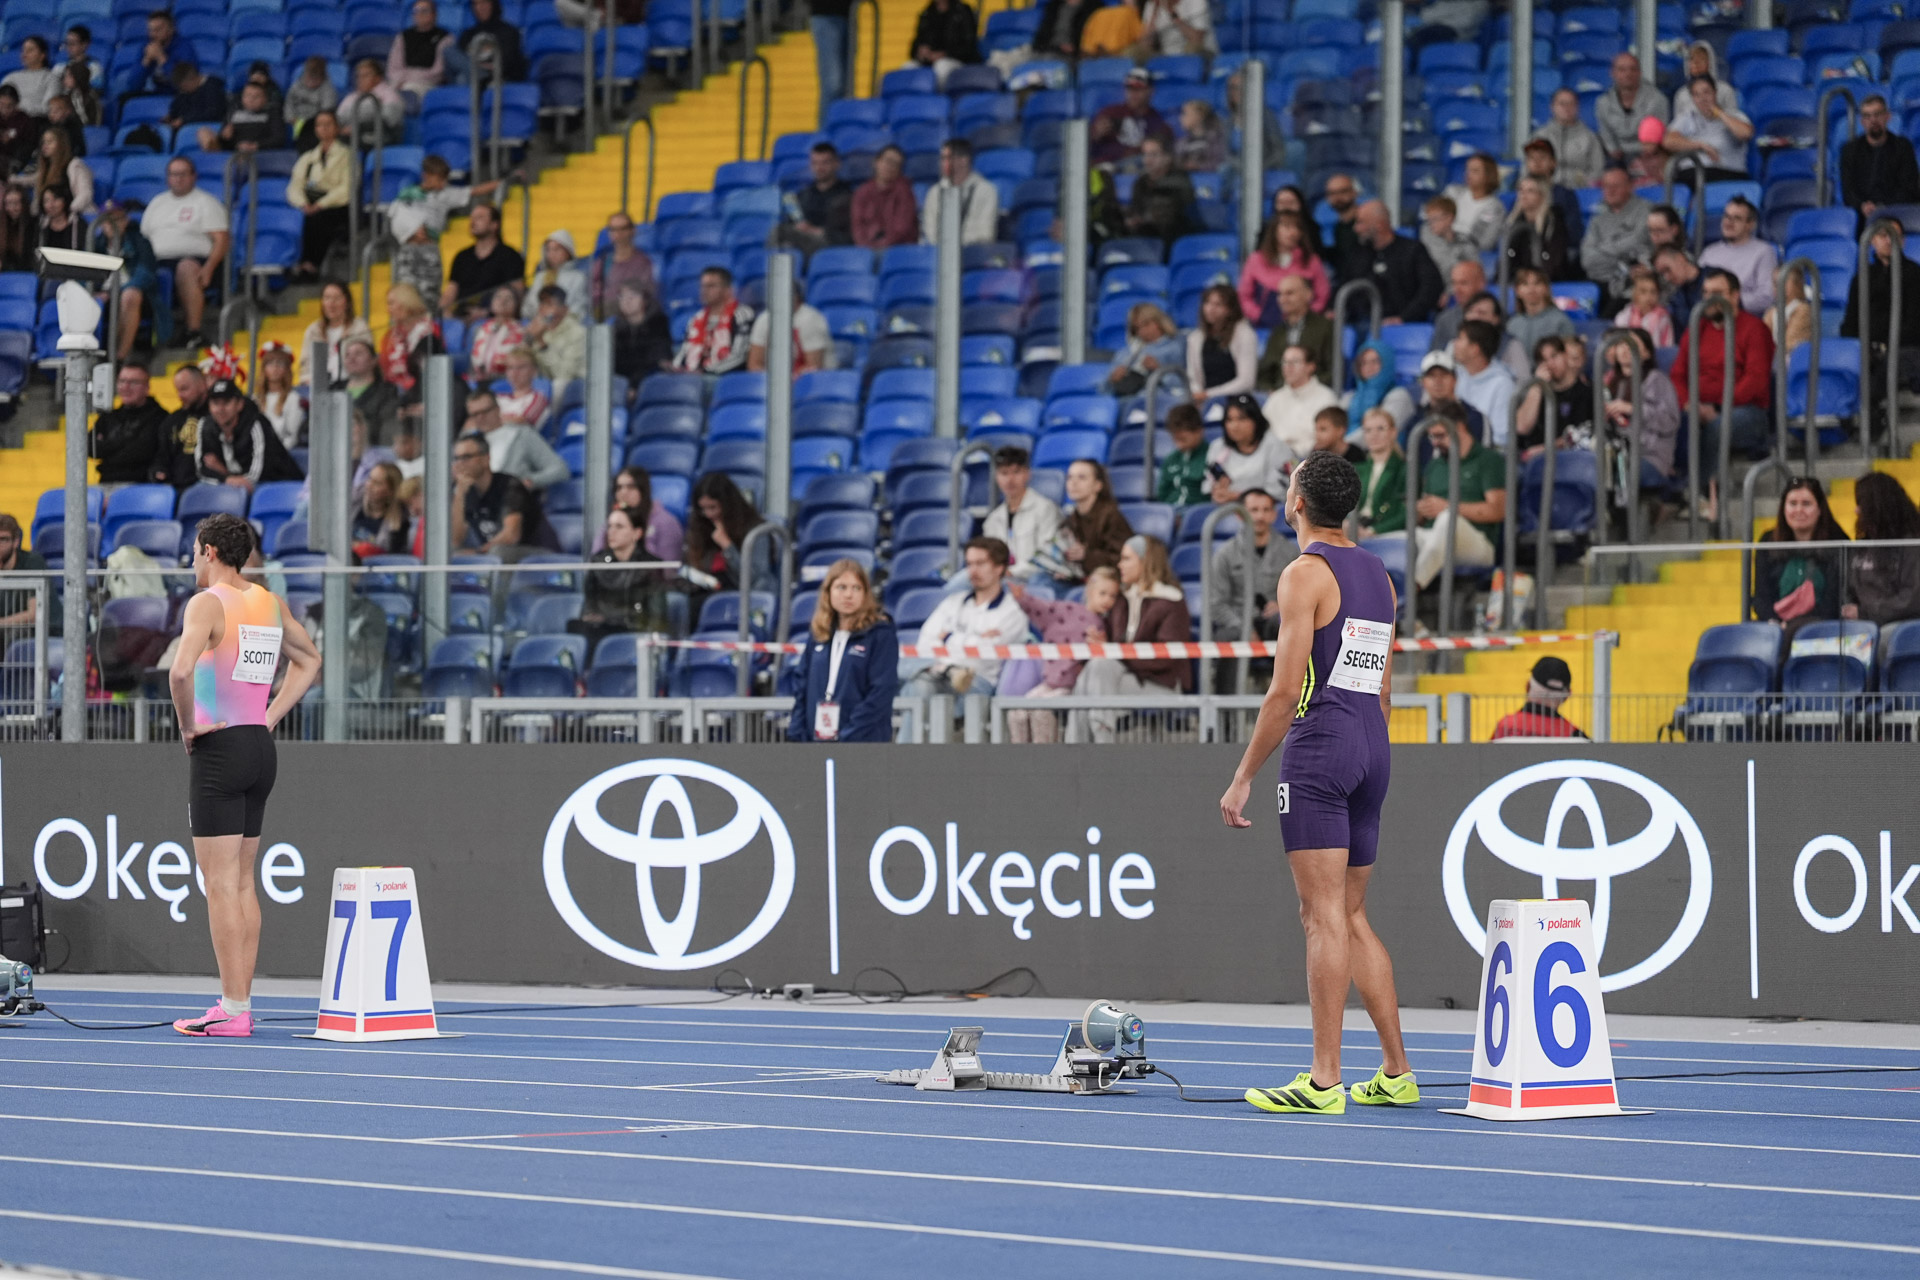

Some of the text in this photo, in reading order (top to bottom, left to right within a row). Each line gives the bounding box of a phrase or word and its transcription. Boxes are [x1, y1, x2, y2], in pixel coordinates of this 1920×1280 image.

[243, 650, 275, 665] SCOTTI
[1343, 649, 1386, 671] SEGERS
[1279, 786, 1285, 812] 6
[33, 814, 305, 923] Okęe
[383, 882, 408, 892] polanik
[869, 822, 1156, 941] Okęcie
[333, 900, 357, 1001] 7
[370, 900, 412, 1002] 7
[1498, 918, 1514, 930] polanik
[1547, 917, 1581, 931] polanik
[1484, 941, 1513, 1068] 6
[1533, 941, 1592, 1069] 6
